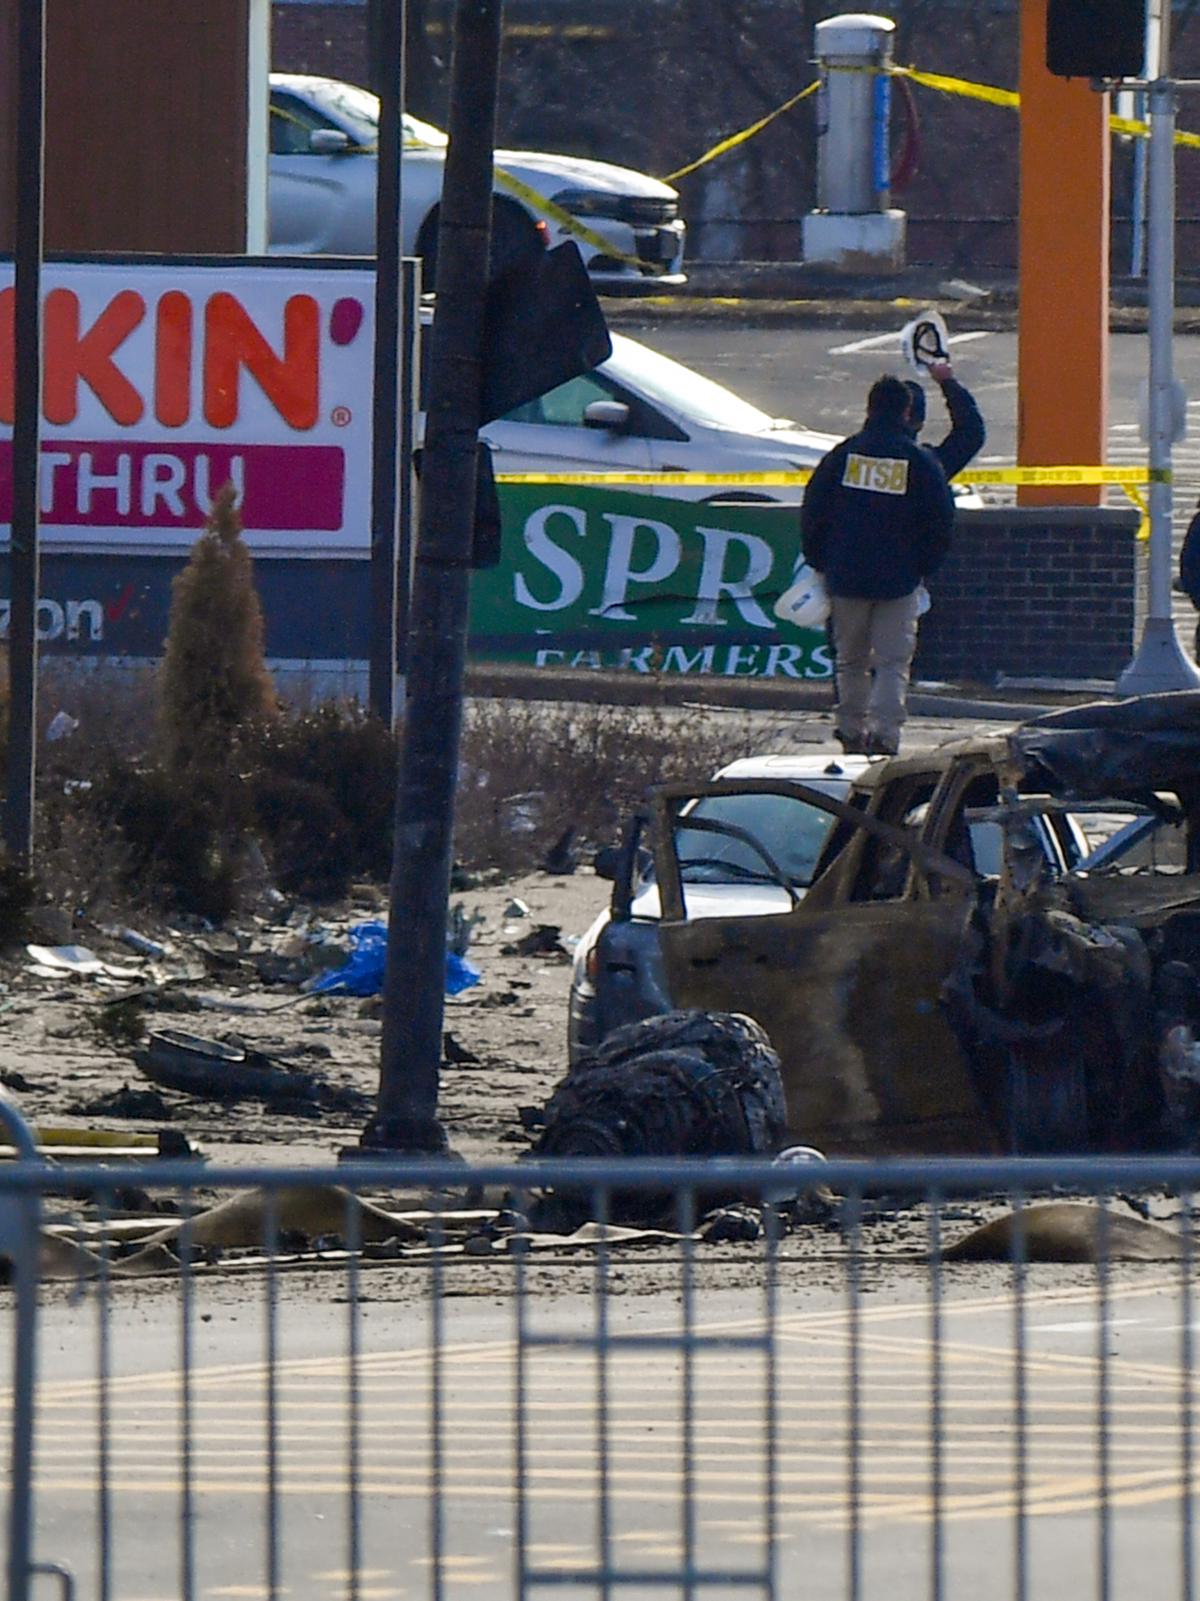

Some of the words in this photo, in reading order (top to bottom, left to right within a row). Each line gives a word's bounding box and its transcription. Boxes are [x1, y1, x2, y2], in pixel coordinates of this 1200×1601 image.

[0, 287, 363, 431] KIN'
[40, 452, 245, 517] THRU
[846, 456, 906, 491] NTSB
[514, 504, 818, 630] SPR
